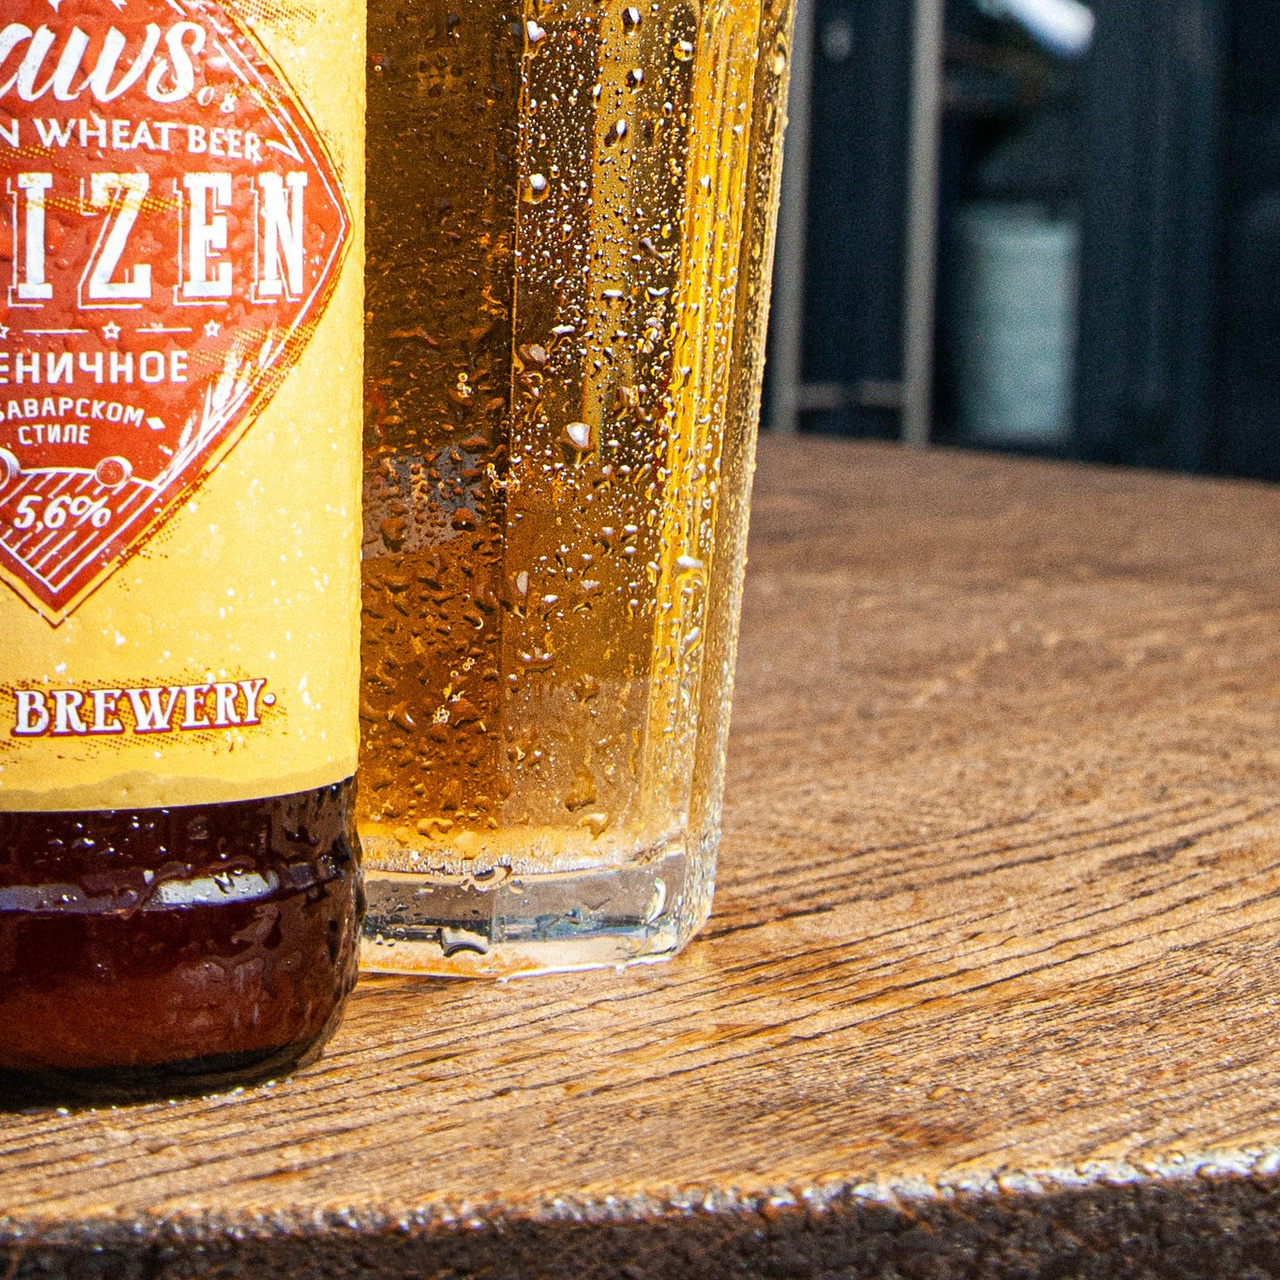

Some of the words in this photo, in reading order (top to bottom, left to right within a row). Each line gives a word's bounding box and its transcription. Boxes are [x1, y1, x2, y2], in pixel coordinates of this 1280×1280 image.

[35, 117, 178, 153] WHEAT
[186, 120, 263, 164] BEER
[17, 423, 92, 446] СТИЛЕ
[12, 493, 113, 534] 5,6%
[10, 676, 267, 738] BREWERY
